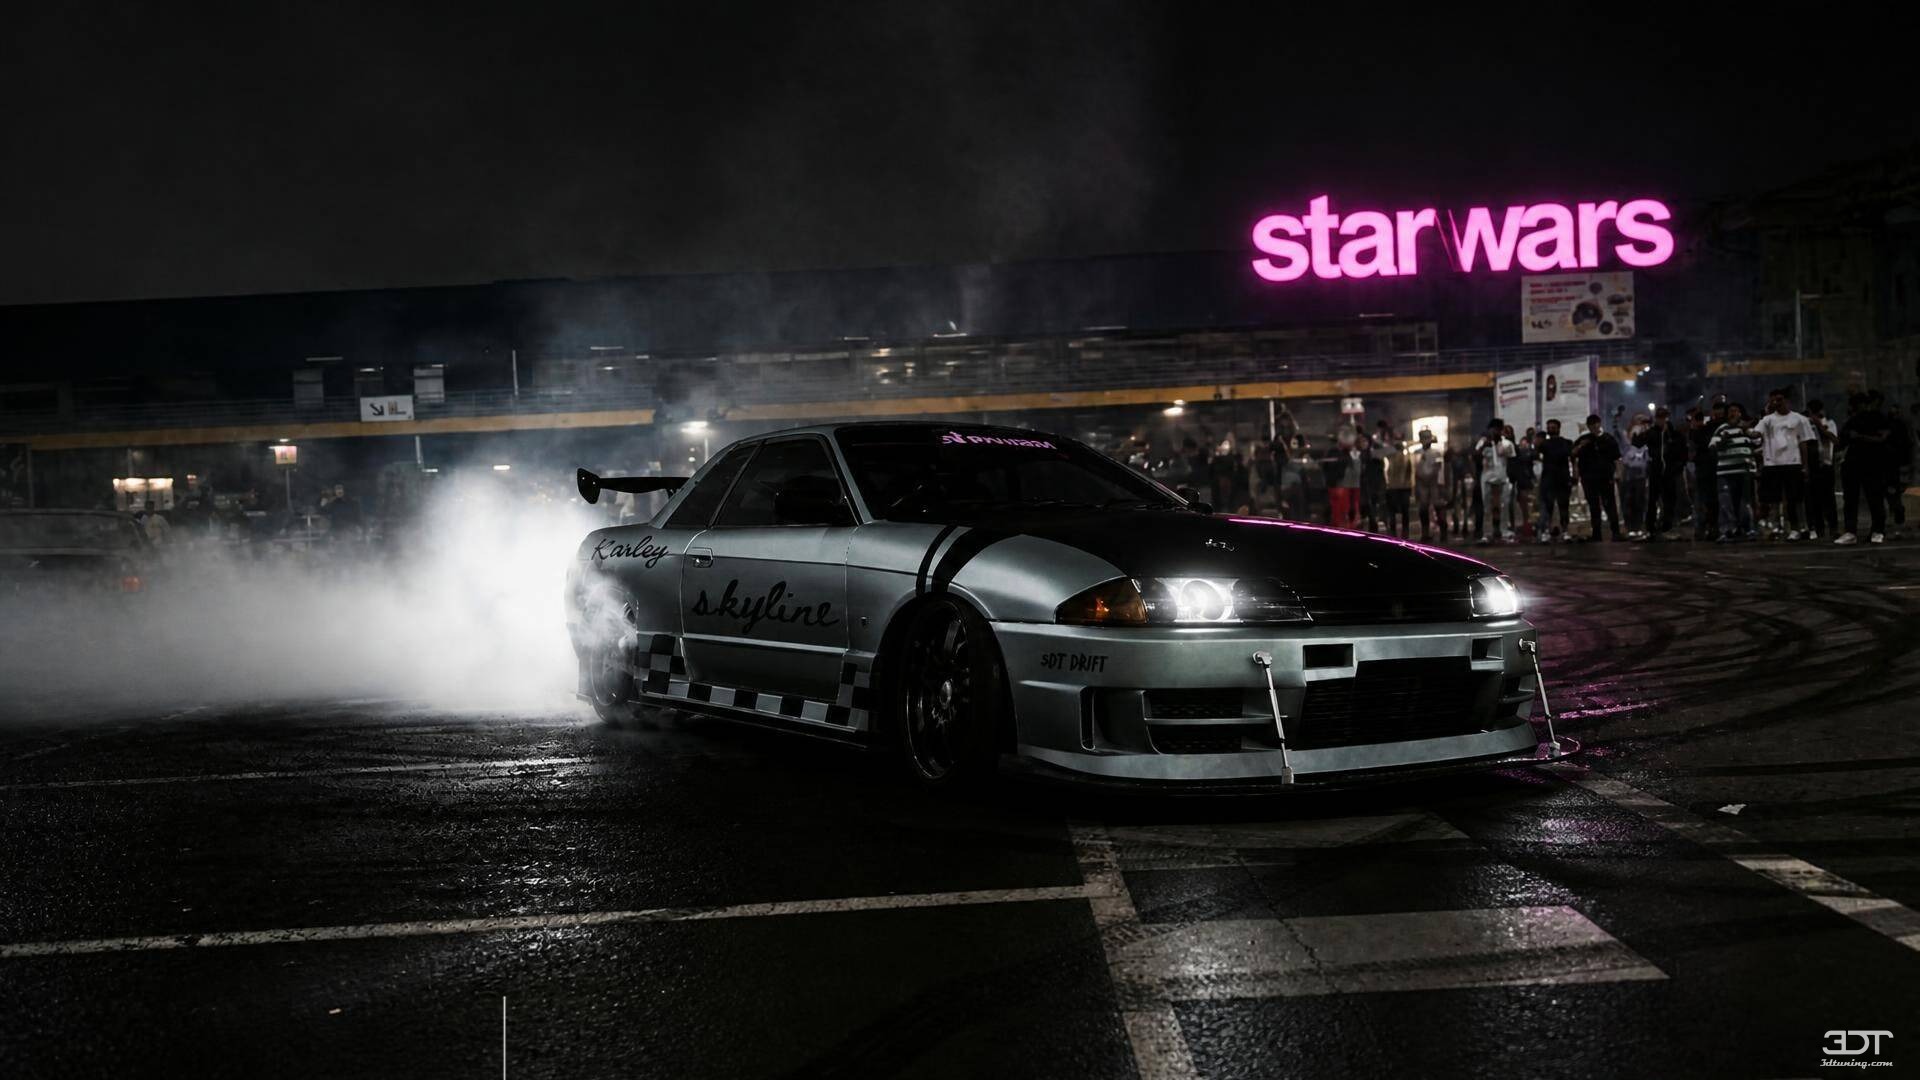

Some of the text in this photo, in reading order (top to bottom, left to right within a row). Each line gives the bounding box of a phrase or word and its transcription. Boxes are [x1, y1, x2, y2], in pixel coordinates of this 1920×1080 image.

[1251, 194, 1675, 282] star wars
[692, 579, 840, 634] skyline
[1069, 652, 1109, 673] DRIFT
